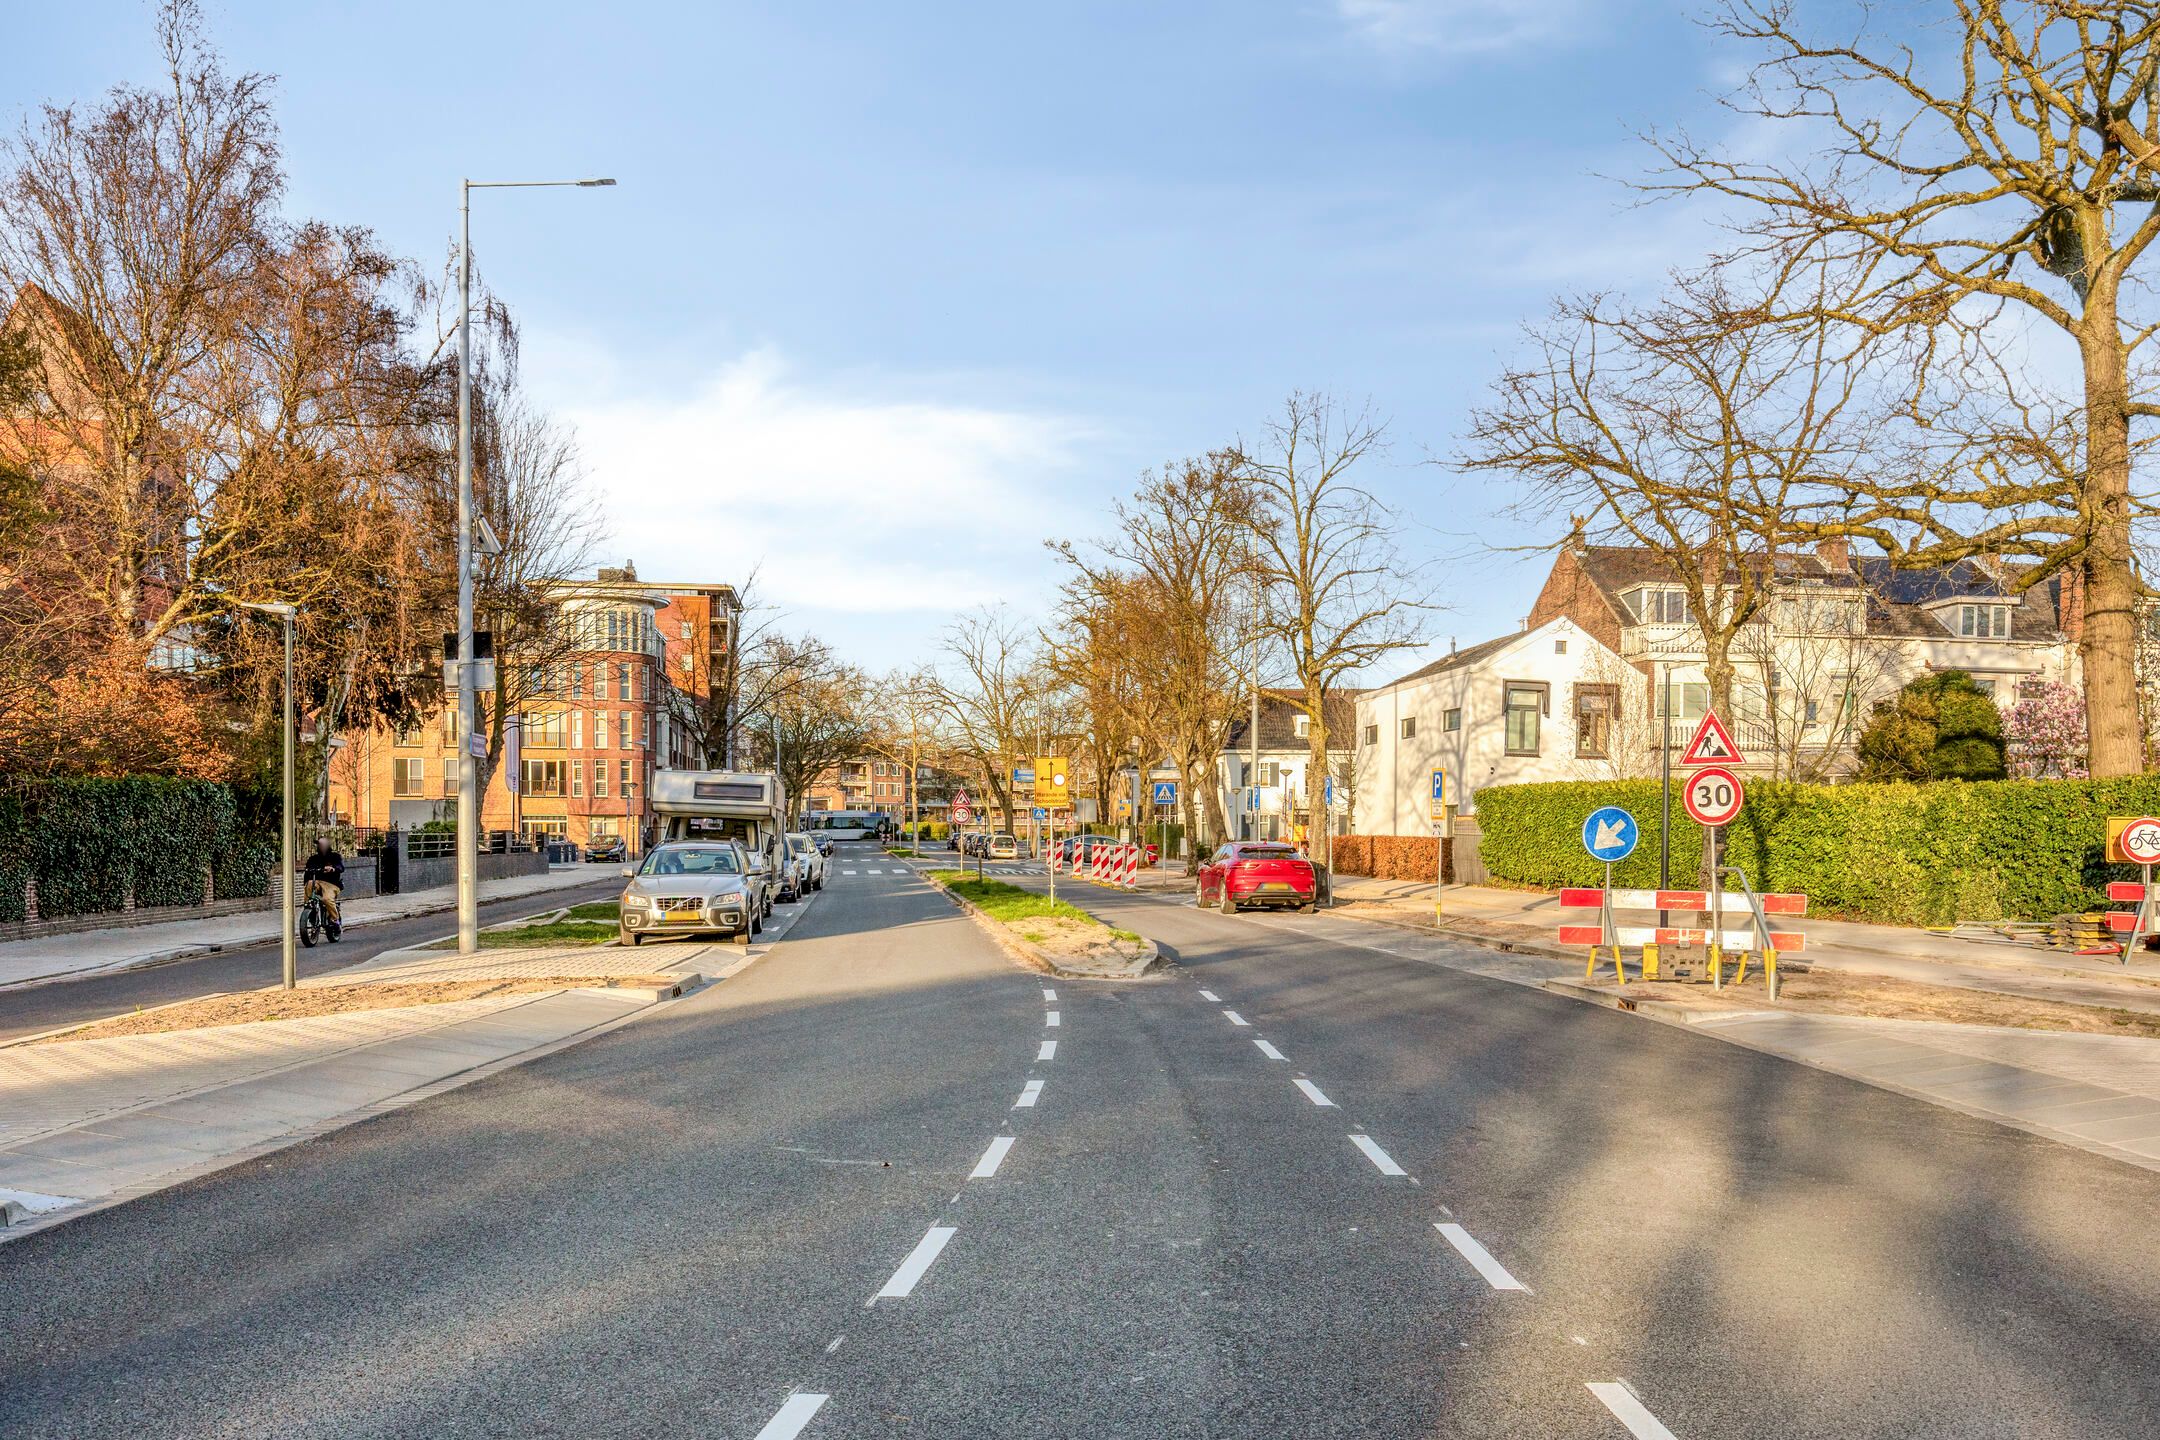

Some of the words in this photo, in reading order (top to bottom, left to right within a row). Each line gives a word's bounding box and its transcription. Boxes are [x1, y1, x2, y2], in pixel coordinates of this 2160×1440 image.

[1434, 774, 1441, 796] P
[1697, 784, 1731, 808] 30
[956, 811, 967, 819] 30
